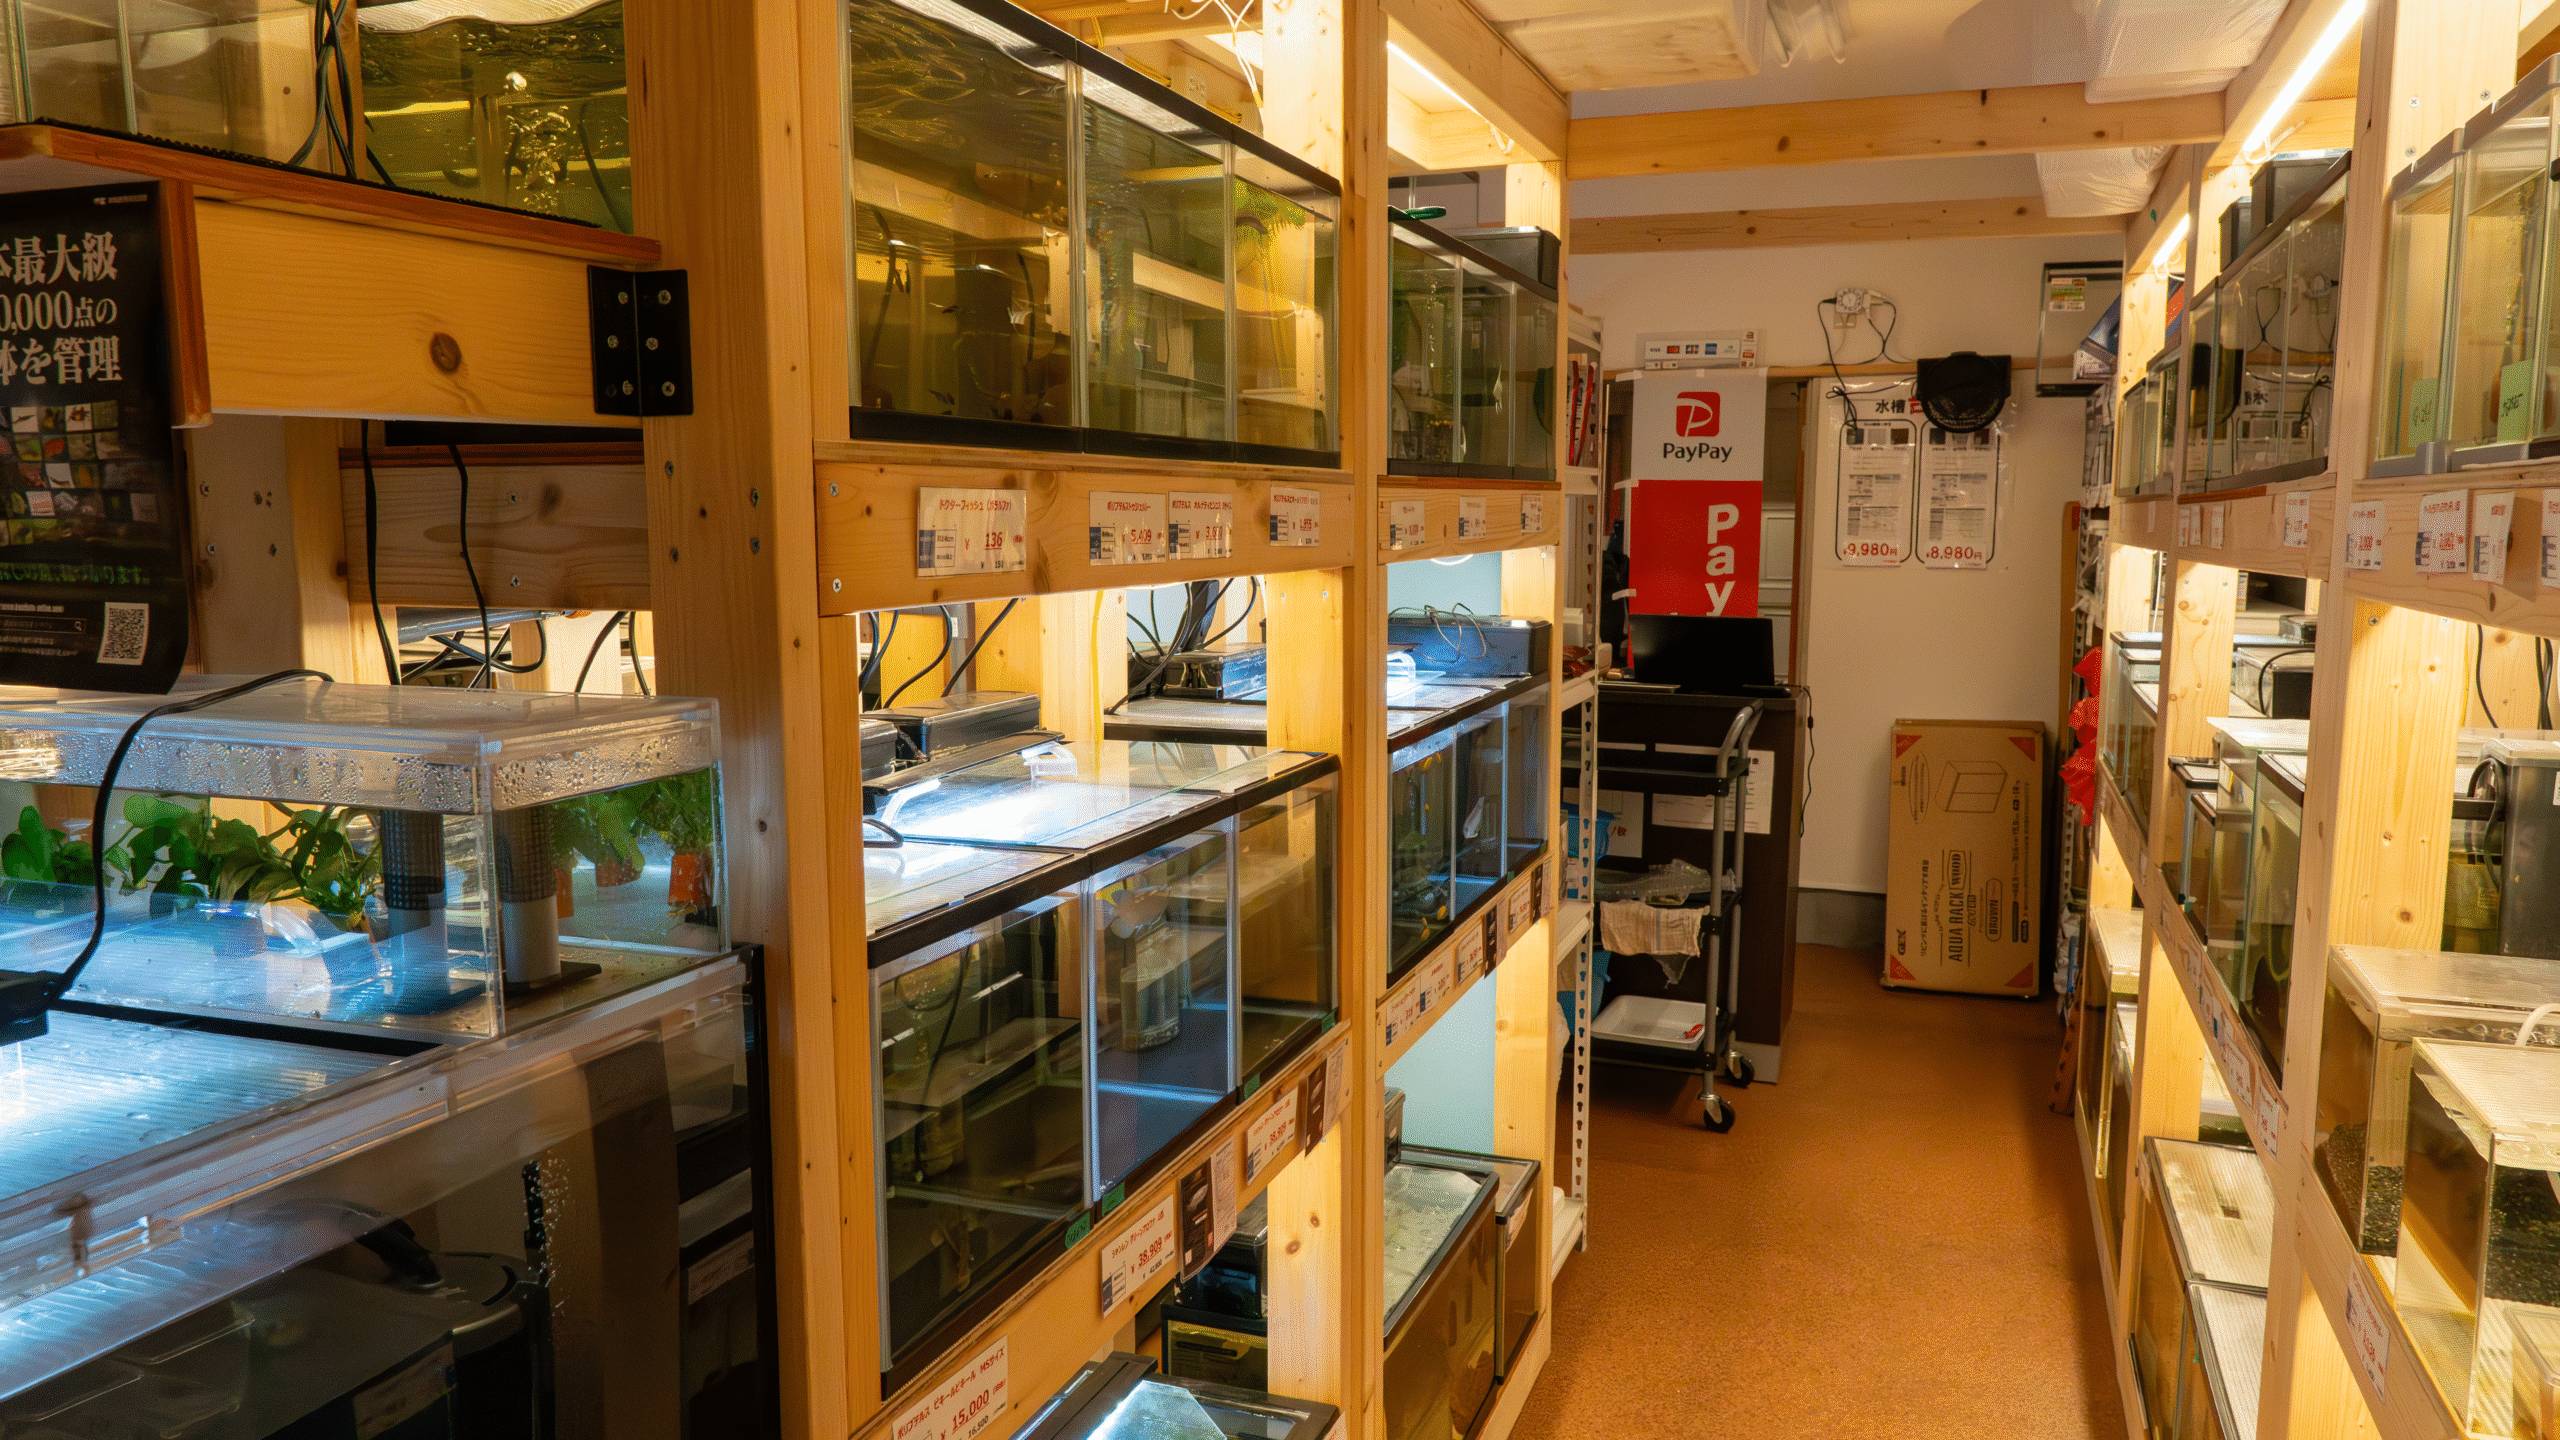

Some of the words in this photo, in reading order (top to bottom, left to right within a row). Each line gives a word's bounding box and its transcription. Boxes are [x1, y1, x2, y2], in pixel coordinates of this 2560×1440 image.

[1663, 443, 1732, 463] PayPay
[985, 532, 1003, 548] 136
[1705, 503, 1739, 616] Pay
[1950, 853, 1962, 886] WOOD
[1949, 891, 1964, 925] RACK
[1989, 899, 1998, 935] BROWN
[1896, 928, 1907, 955] GEX
[1948, 927, 1963, 962] AQUA
[952, 1390, 989, 1430] 15,000
